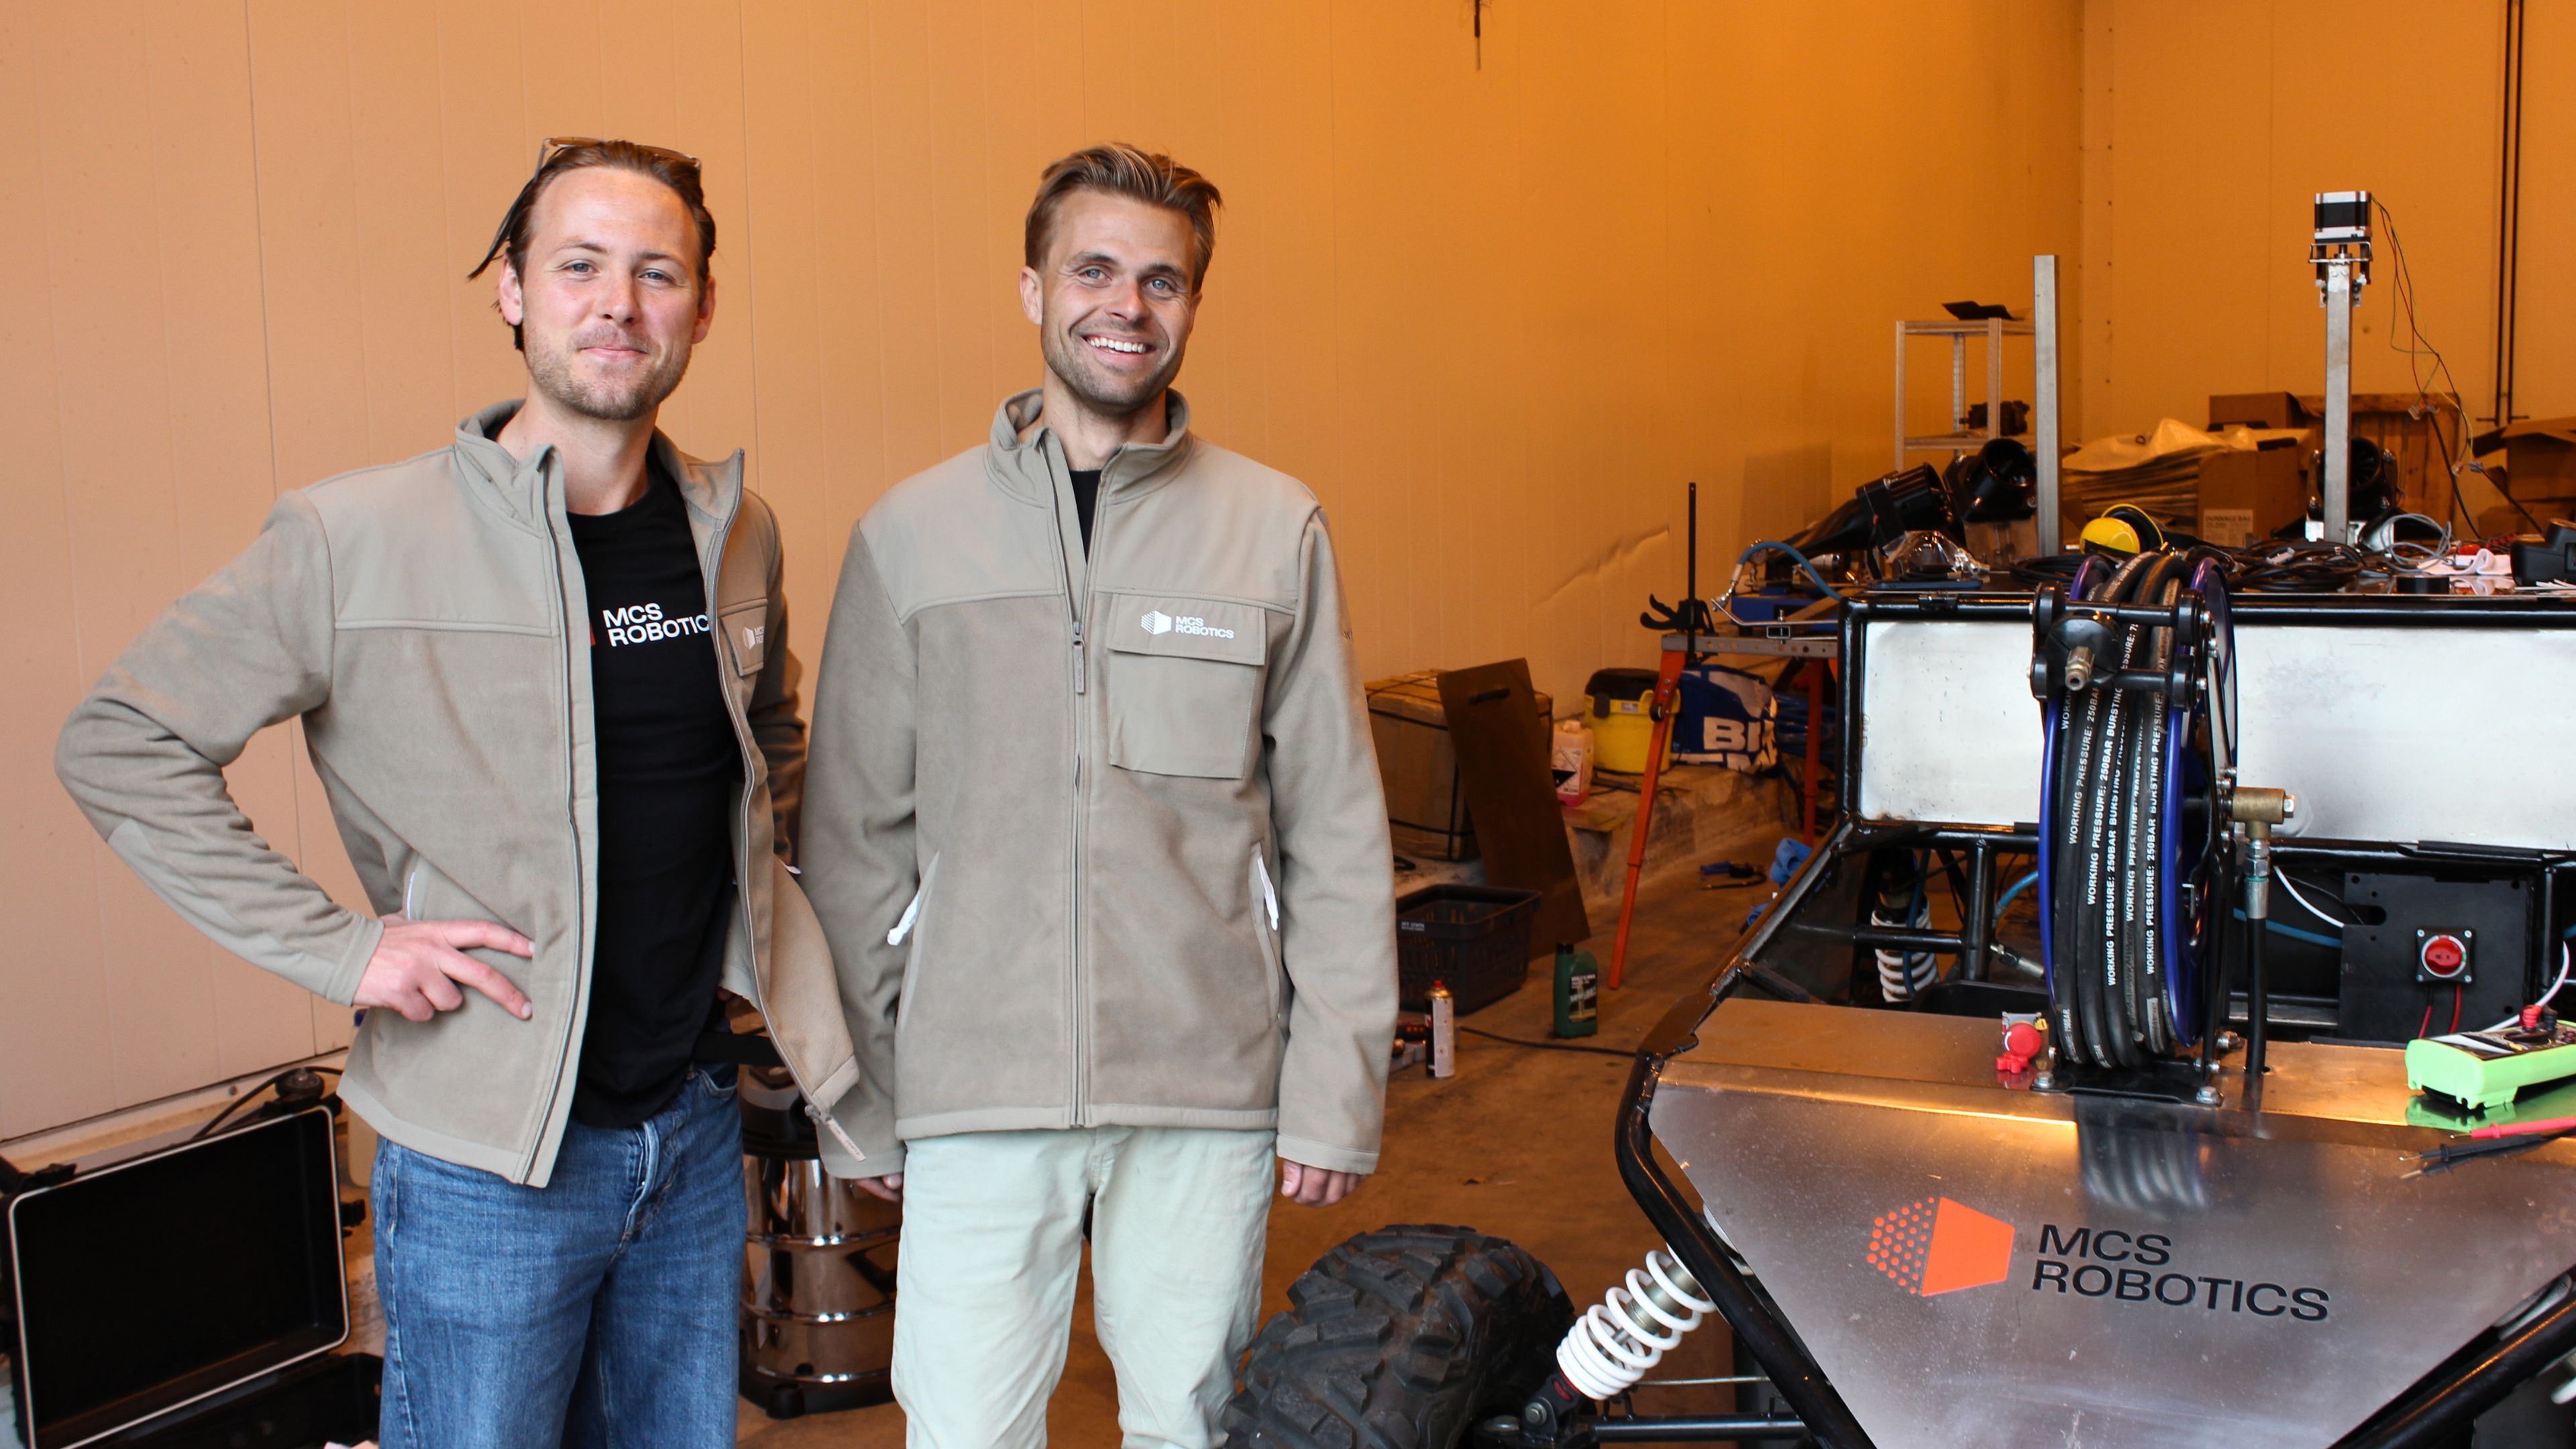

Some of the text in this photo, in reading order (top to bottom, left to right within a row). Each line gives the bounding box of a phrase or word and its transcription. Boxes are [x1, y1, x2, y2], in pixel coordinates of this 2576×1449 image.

[602, 602, 663, 629] MCS
[607, 614, 710, 647] ROBOTIC
[1175, 615, 1204, 627] MCS
[1175, 624, 1235, 639] ROBOTICS
[2149, 757, 2159, 814] BURSTING
[2069, 790, 2083, 845] WORKING
[2087, 852, 2100, 906] WORKING
[2099, 739, 2114, 782] 250BAR
[2147, 818, 2157, 861] 250BAR
[2106, 829, 2117, 873] 250BAR
[2105, 875, 2116, 937] PRESSURE:
[2125, 869, 2136, 922] WORKING
[2145, 865, 2155, 926] PRESSURE:
[2105, 940, 2116, 987] WORKING
[2146, 929, 2155, 975] WORKING
[2038, 1224, 2172, 1266] MCS
[2032, 1259, 2330, 1322] ROBOTICS
